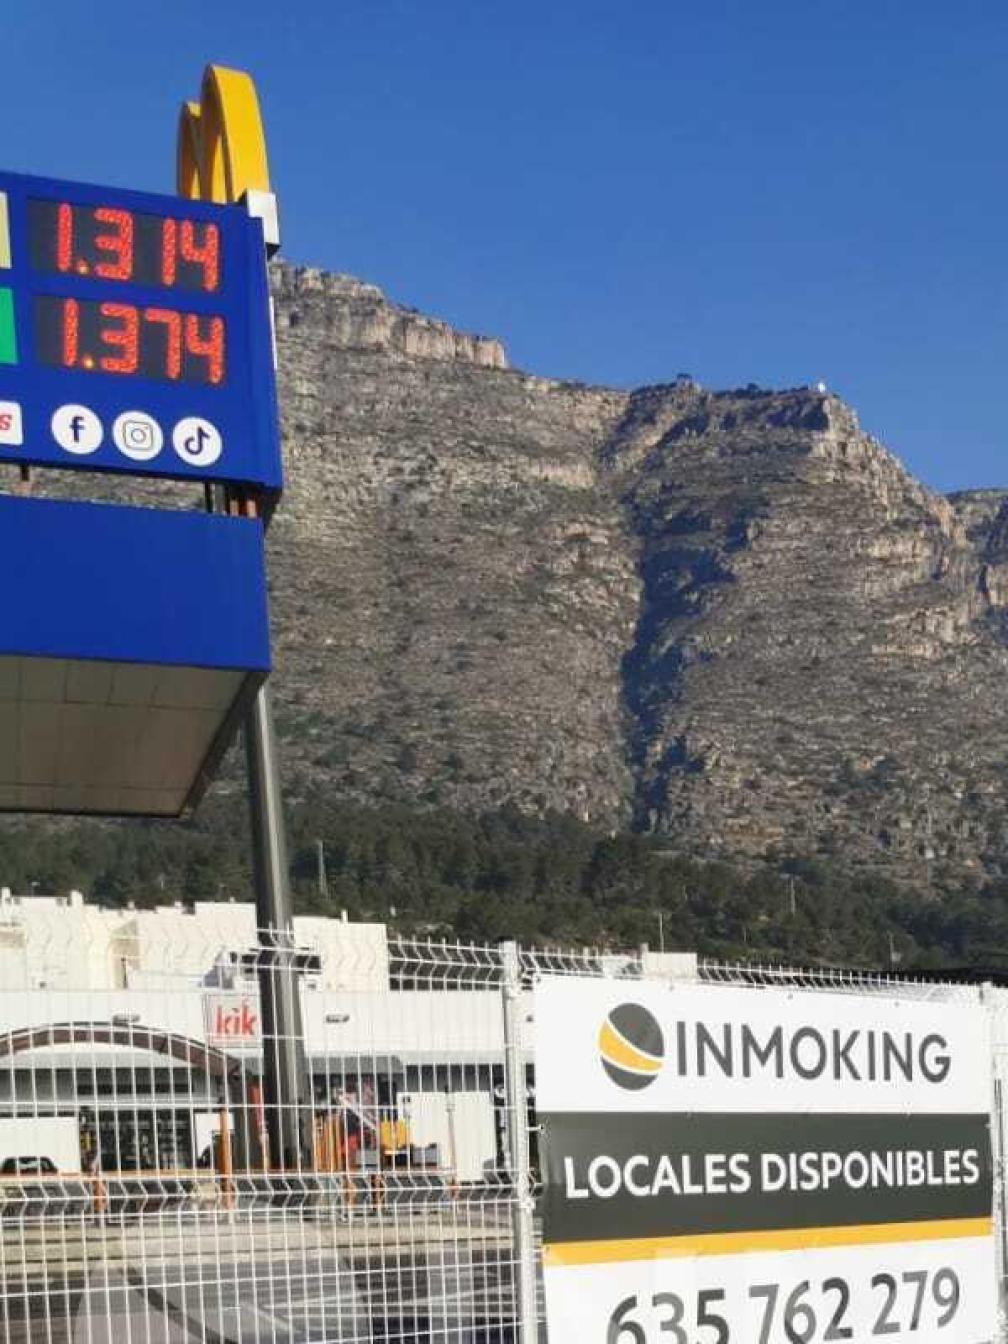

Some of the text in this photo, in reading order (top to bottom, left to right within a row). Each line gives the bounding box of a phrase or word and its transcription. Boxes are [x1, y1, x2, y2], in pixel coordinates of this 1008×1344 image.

[56, 202, 219, 291] 1.314
[62, 298, 226, 384] 1.374
[216, 1004, 258, 1036] kik
[676, 1020, 952, 1083] INMOKING
[564, 1149, 980, 1198] LOCALES DISPONIBLES
[870, 1266, 960, 1335] 279
